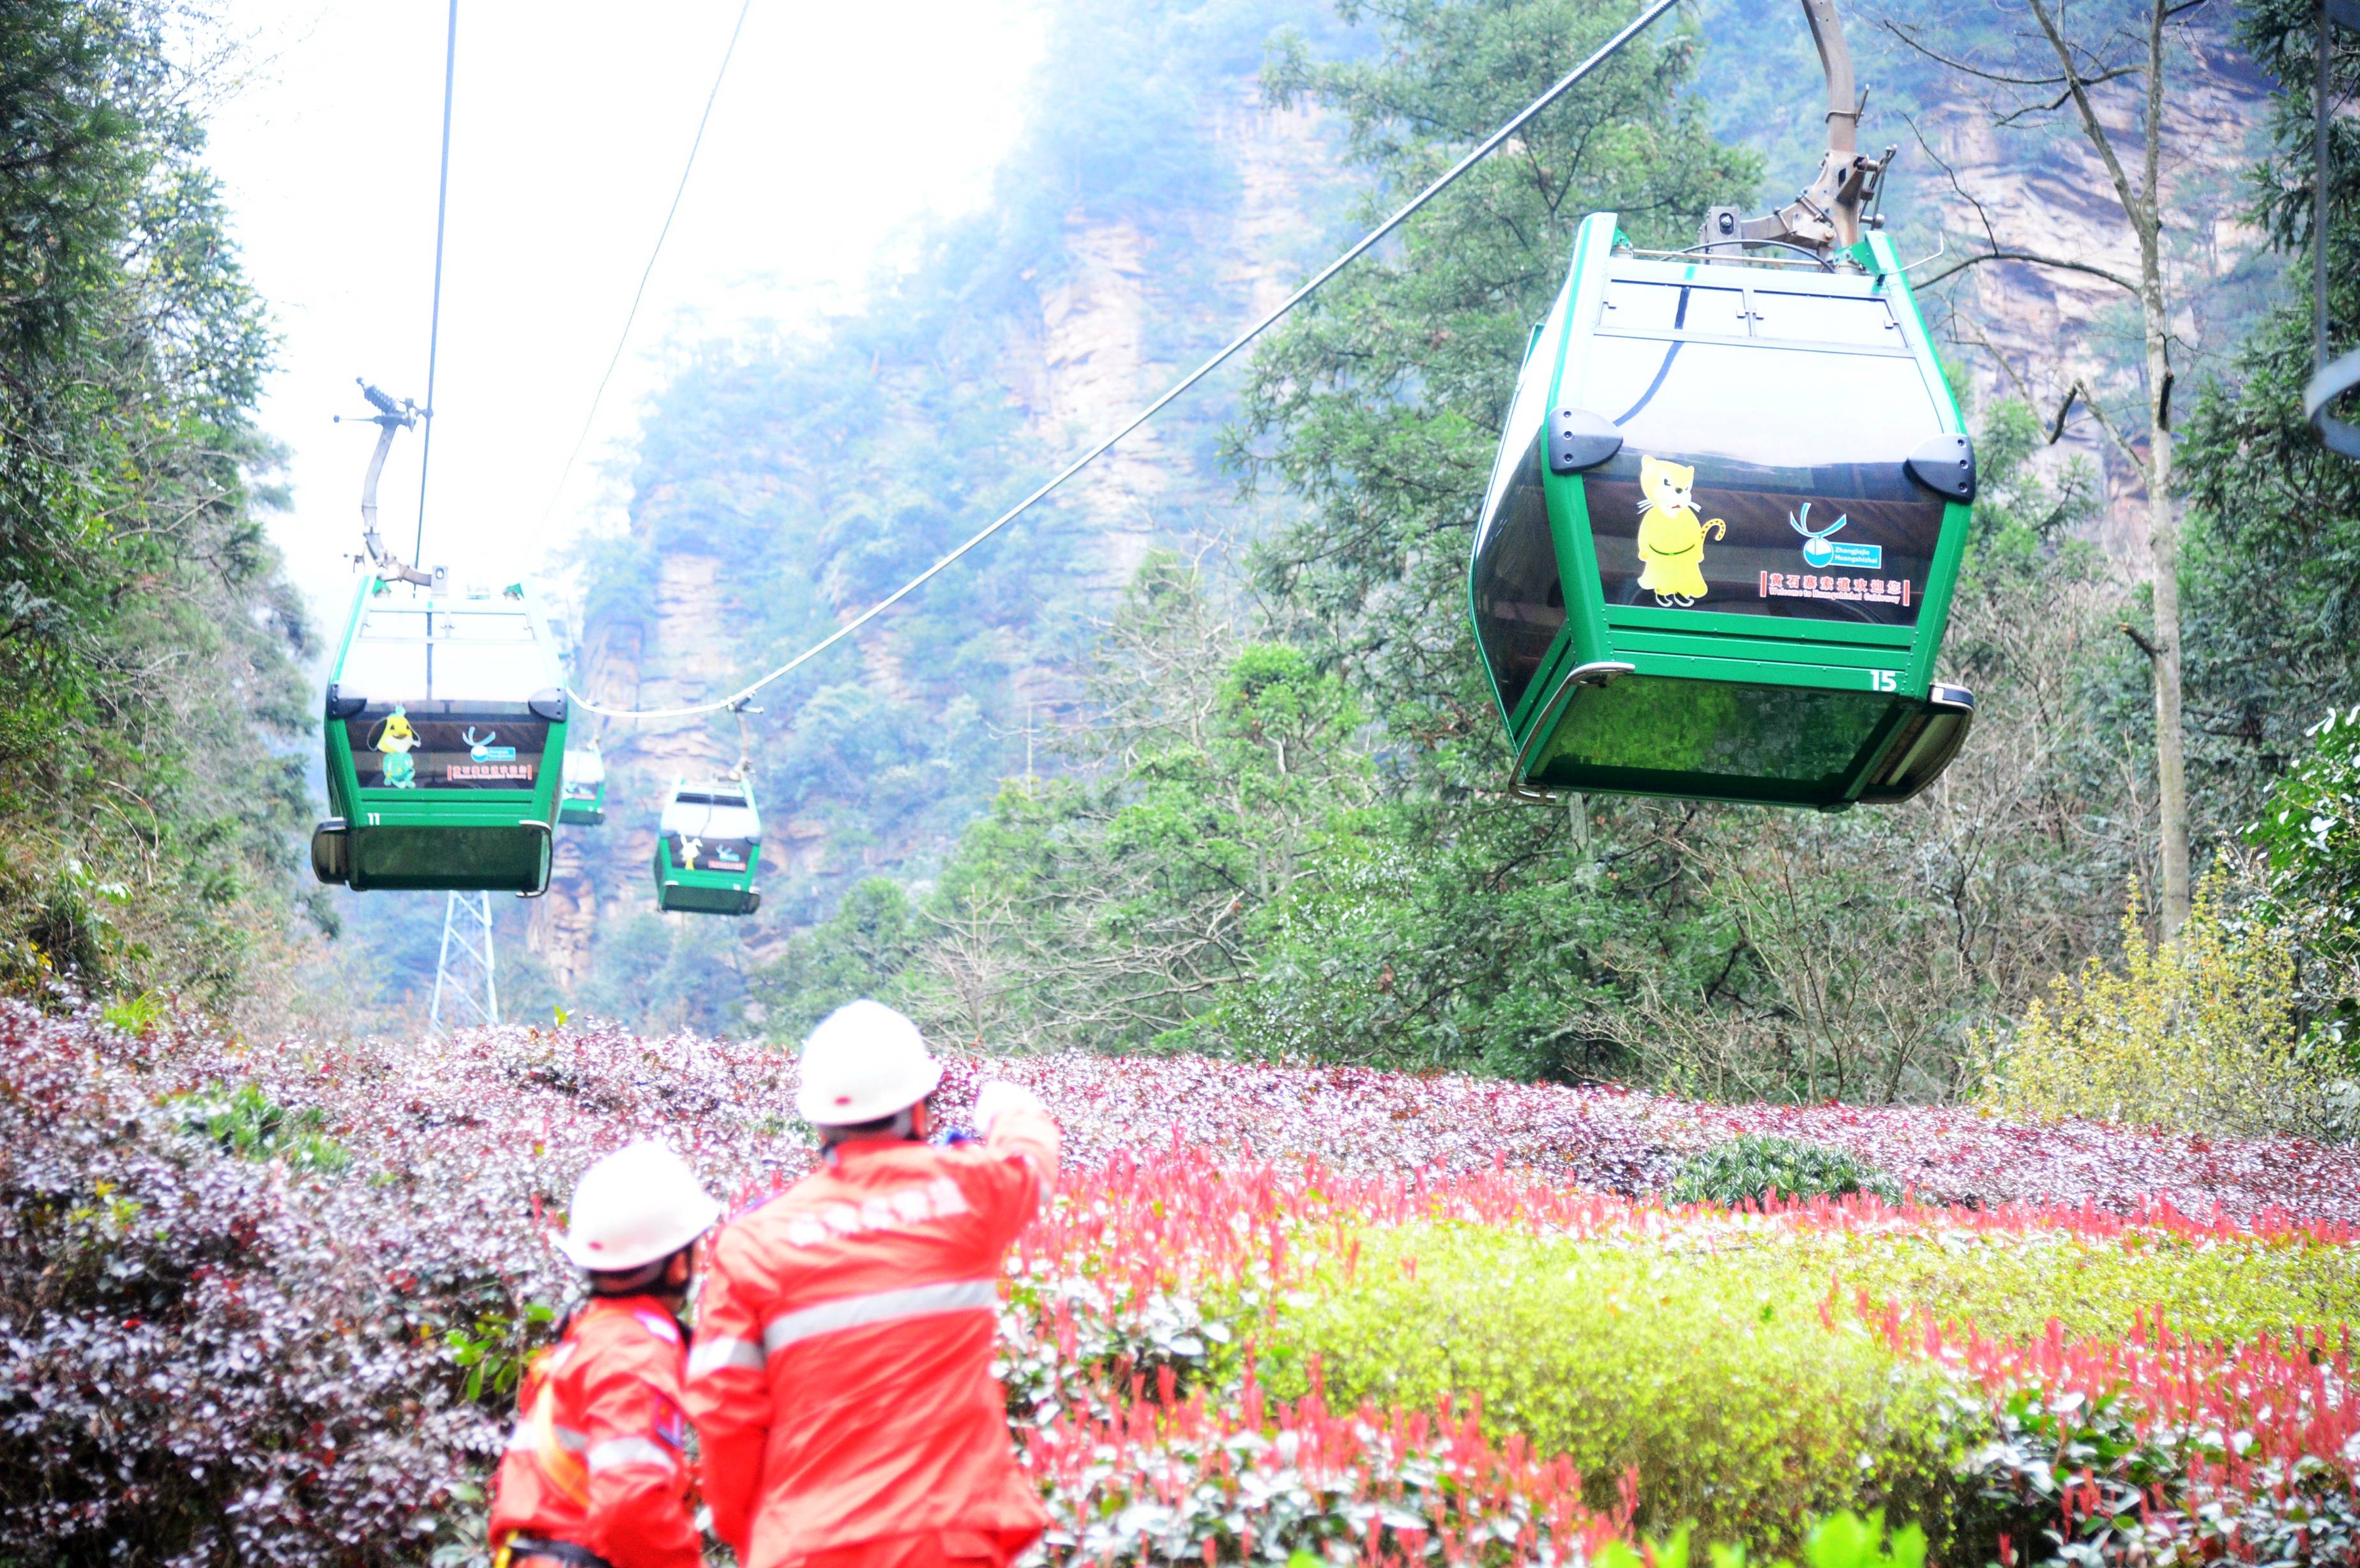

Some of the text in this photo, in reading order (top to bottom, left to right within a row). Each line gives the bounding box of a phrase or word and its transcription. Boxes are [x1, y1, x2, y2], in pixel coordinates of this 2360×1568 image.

[1835, 547, 1870, 555] Zhangjiajie
[1834, 555, 1877, 564] Huangshizhai
[1769, 573, 1902, 594] 黄石寨索道欢迎您
[1769, 587, 1803, 597] Welcome
[1870, 670, 1896, 692] 15
[368, 813, 380, 825] 11
